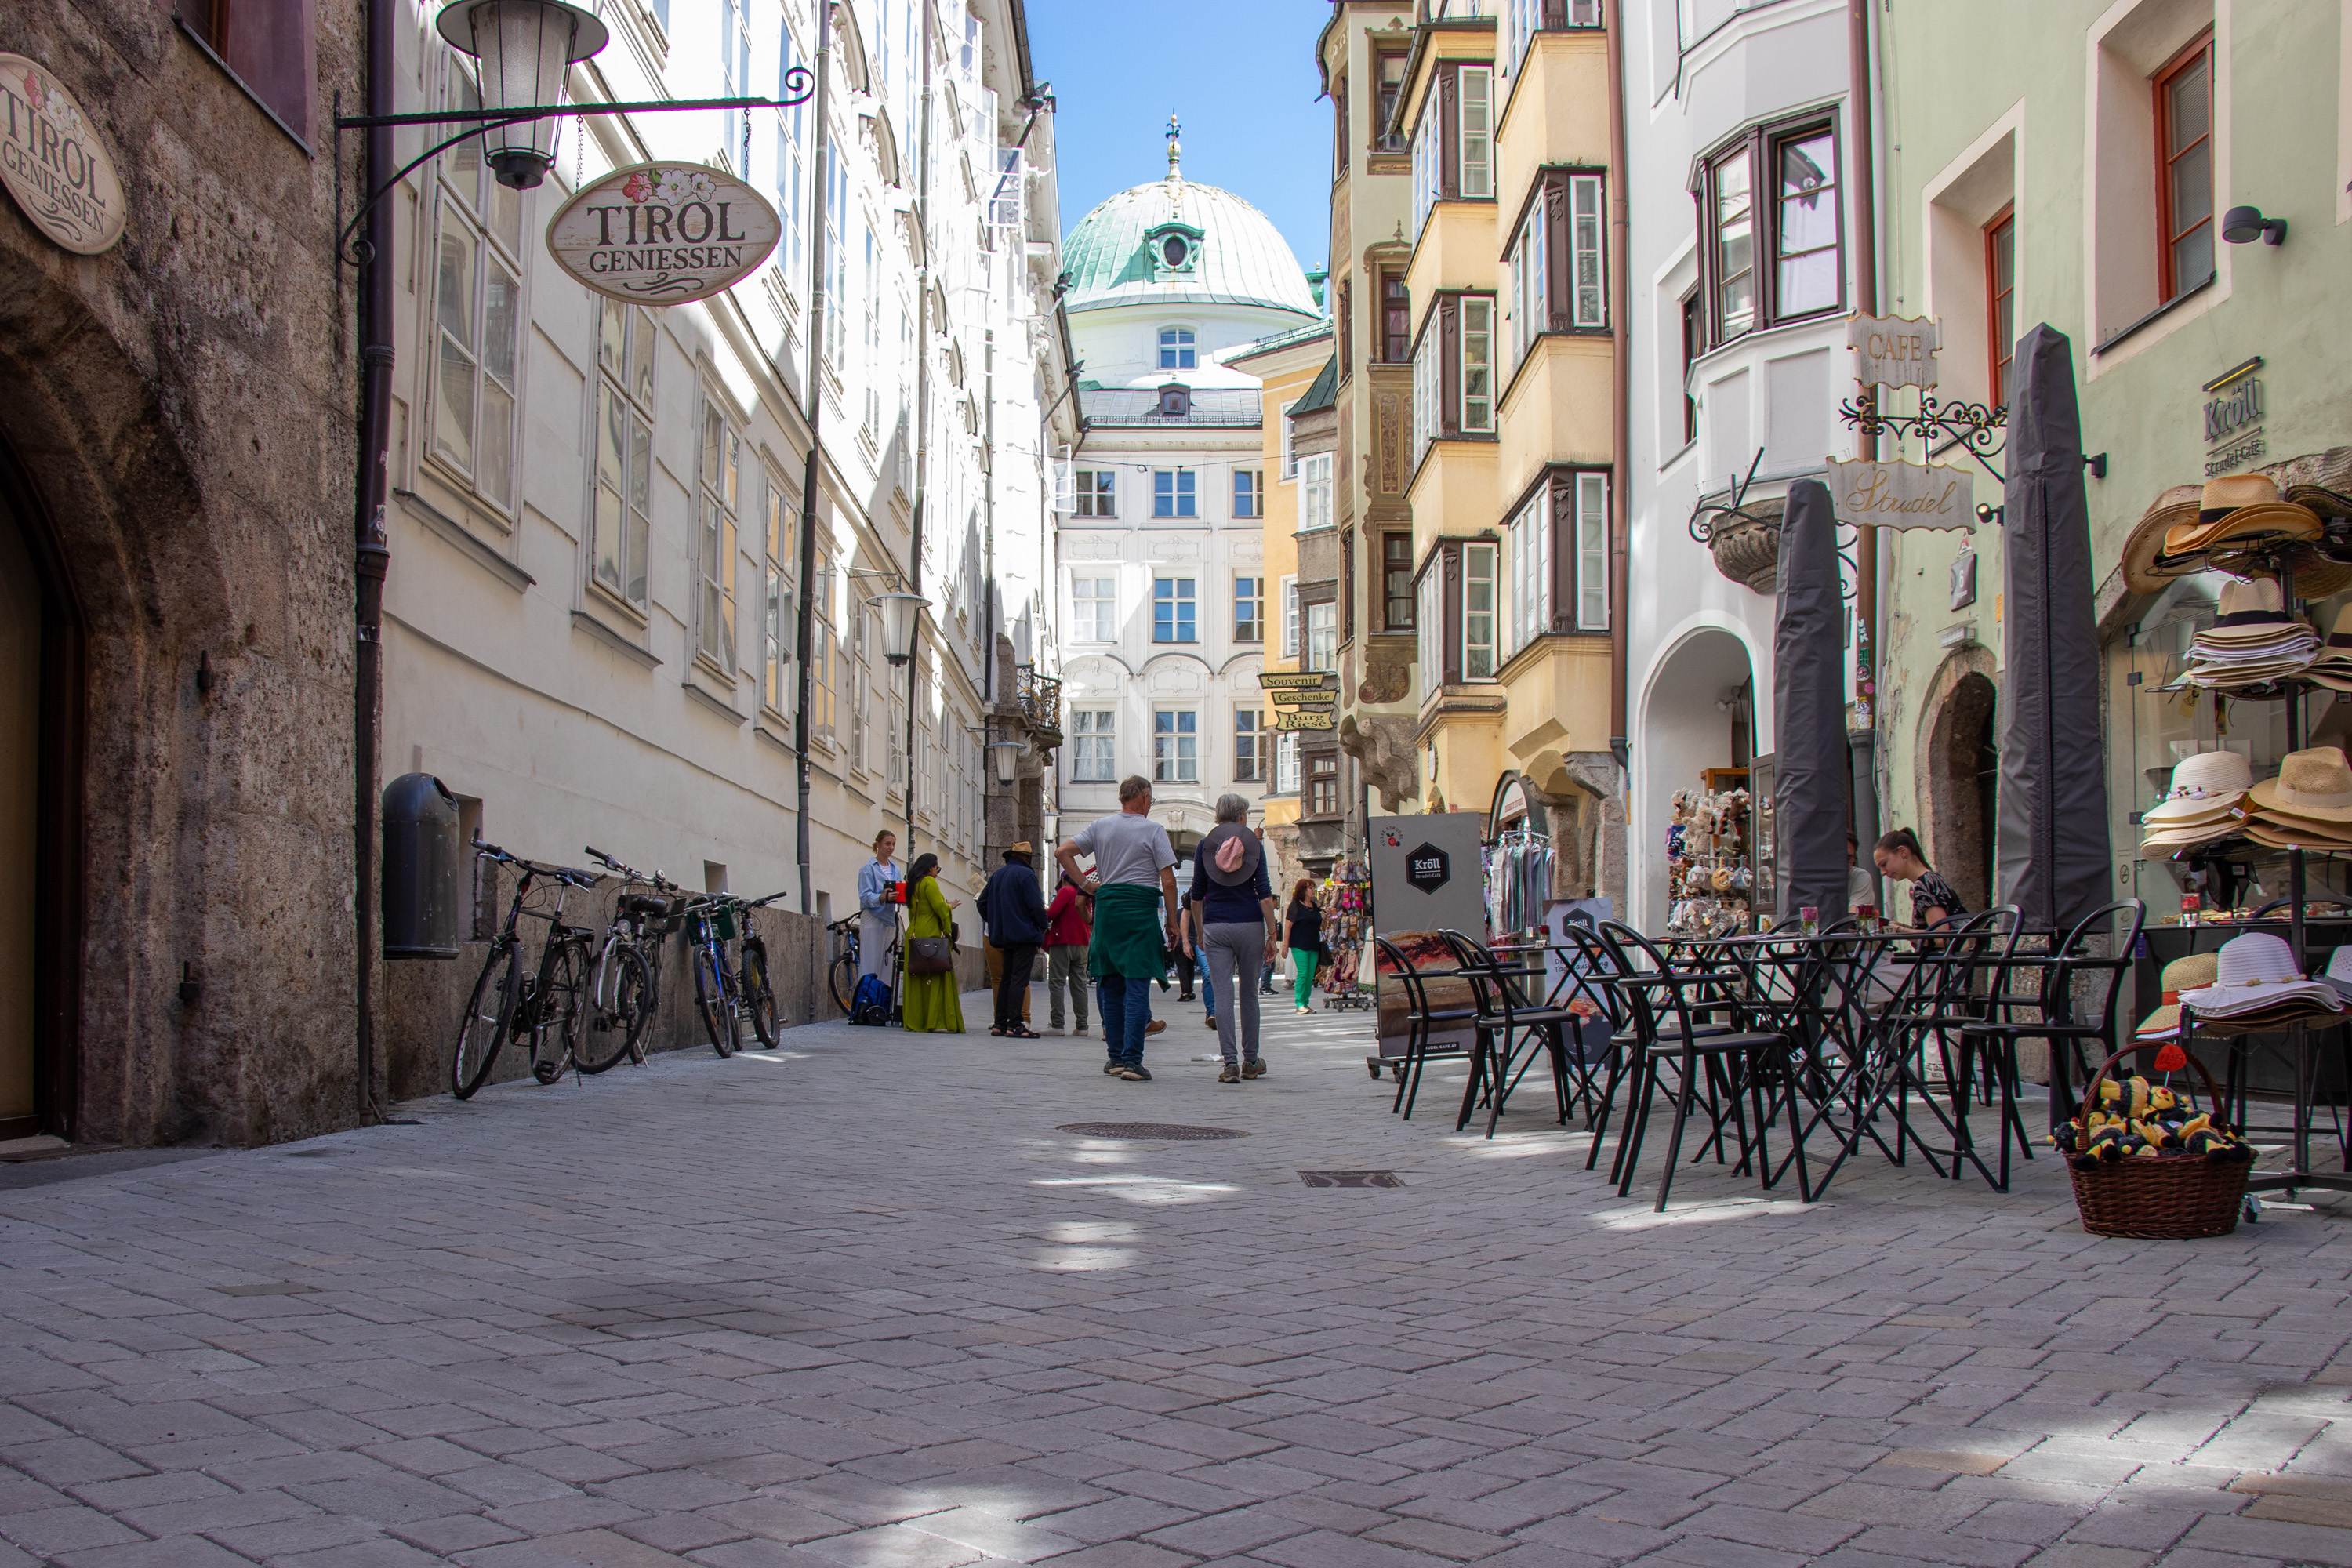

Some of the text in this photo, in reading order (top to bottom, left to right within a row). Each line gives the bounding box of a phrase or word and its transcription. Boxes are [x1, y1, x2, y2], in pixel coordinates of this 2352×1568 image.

[0, 83, 106, 209] TIROL
[3, 140, 105, 237] GENIESSEN
[586, 201, 746, 246] TIROL
[589, 246, 743, 273] GENIESSEN
[1868, 332, 1922, 361] CAFE
[2203, 376, 2259, 441] Kröll
[1846, 469, 1957, 514] Strudel
[1959, 569, 1964, 588] 6
[1266, 675, 1318, 686] Souvenir
[1279, 692, 1330, 702] Geschenke
[1386, 826, 1403, 840] STRUDEL
[1414, 858, 1441, 869] Kröll
